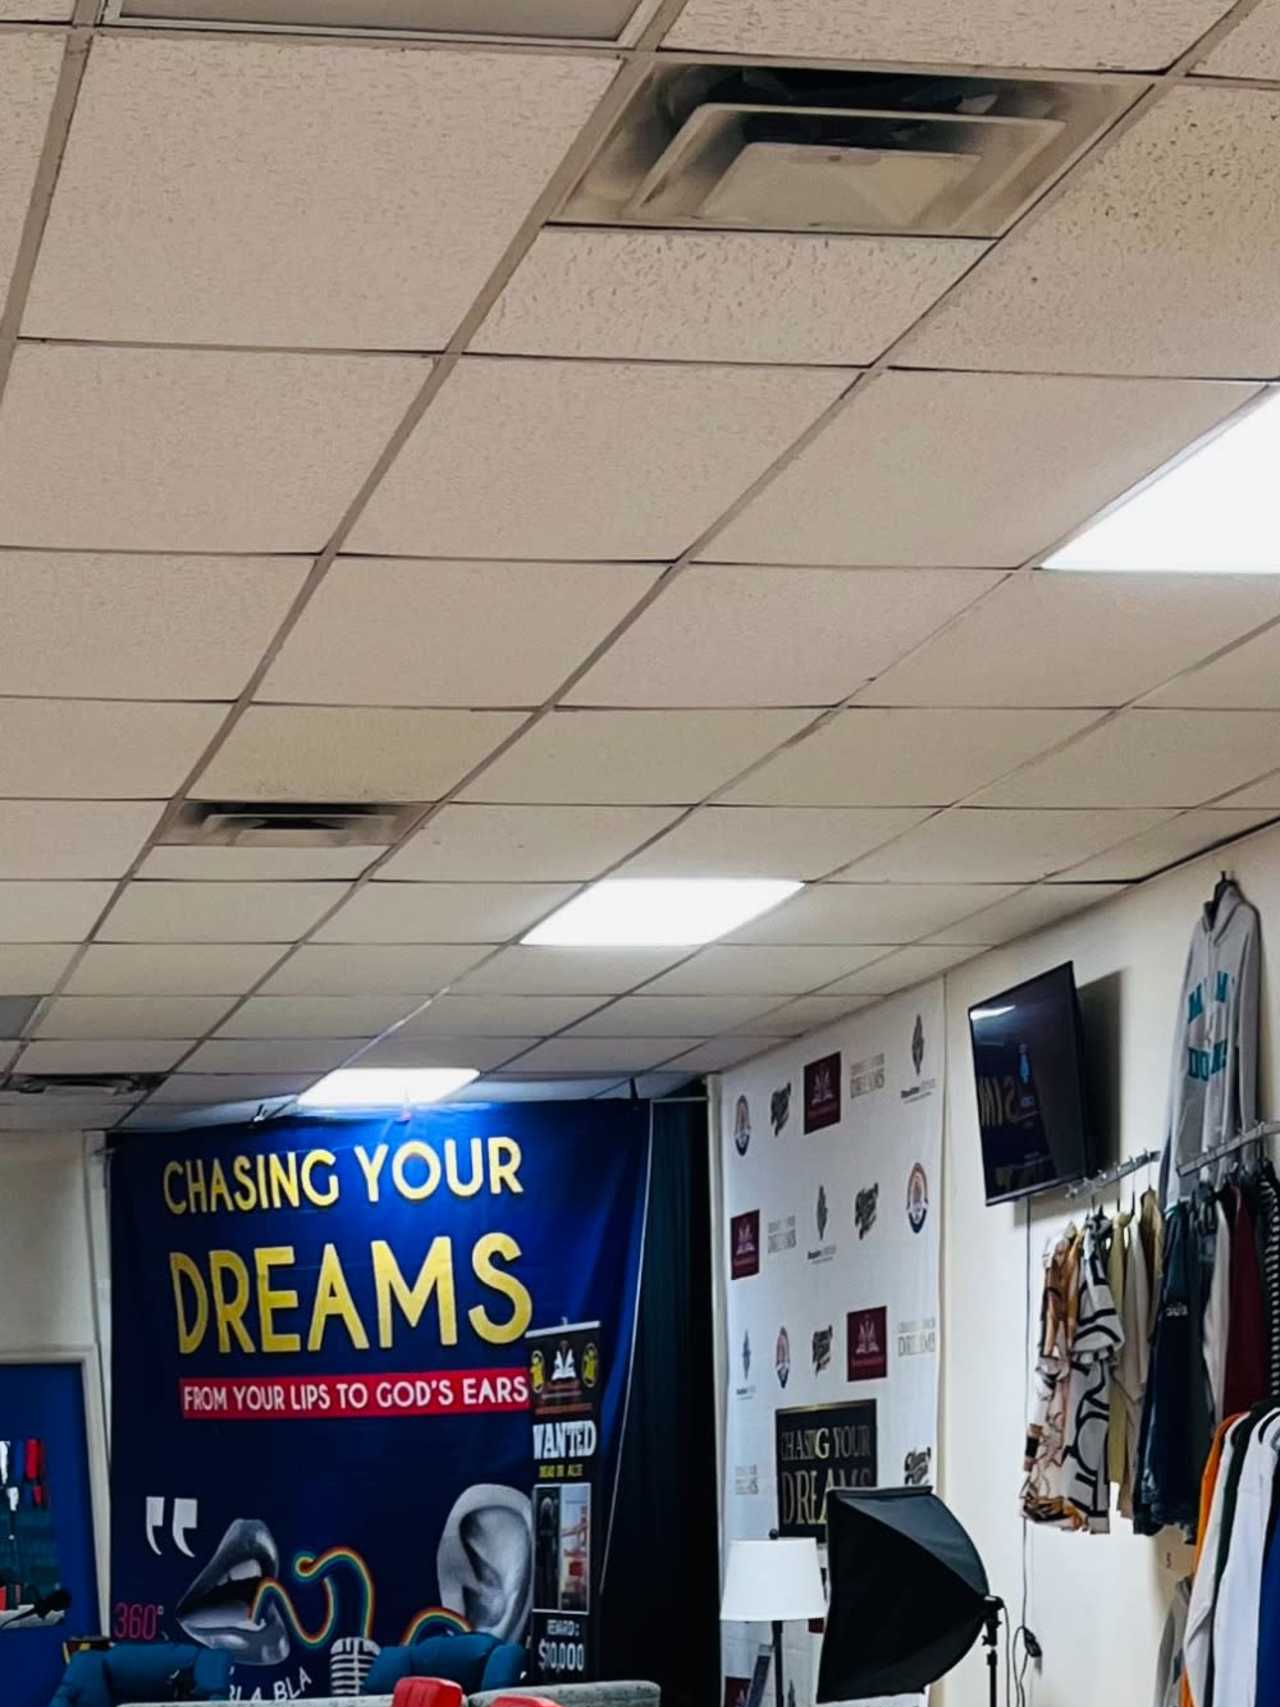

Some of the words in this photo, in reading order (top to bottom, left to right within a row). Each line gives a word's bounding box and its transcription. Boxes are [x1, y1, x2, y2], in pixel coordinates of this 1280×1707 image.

[163, 1148, 339, 1214] CHASING
[353, 1136, 524, 1203] YOUR
[169, 1231, 533, 1354] DREAMS
[183, 1386, 228, 1411] FROM
[233, 1384, 285, 1411] YOUR
[290, 1382, 331, 1410] LIPS
[336, 1382, 368, 1409] TO
[376, 1379, 454, 1408] GOD'S
[462, 1375, 529, 1405] EARS
[532, 1419, 597, 1460] WANTED
[272, 1666, 313, 1702] BLA
